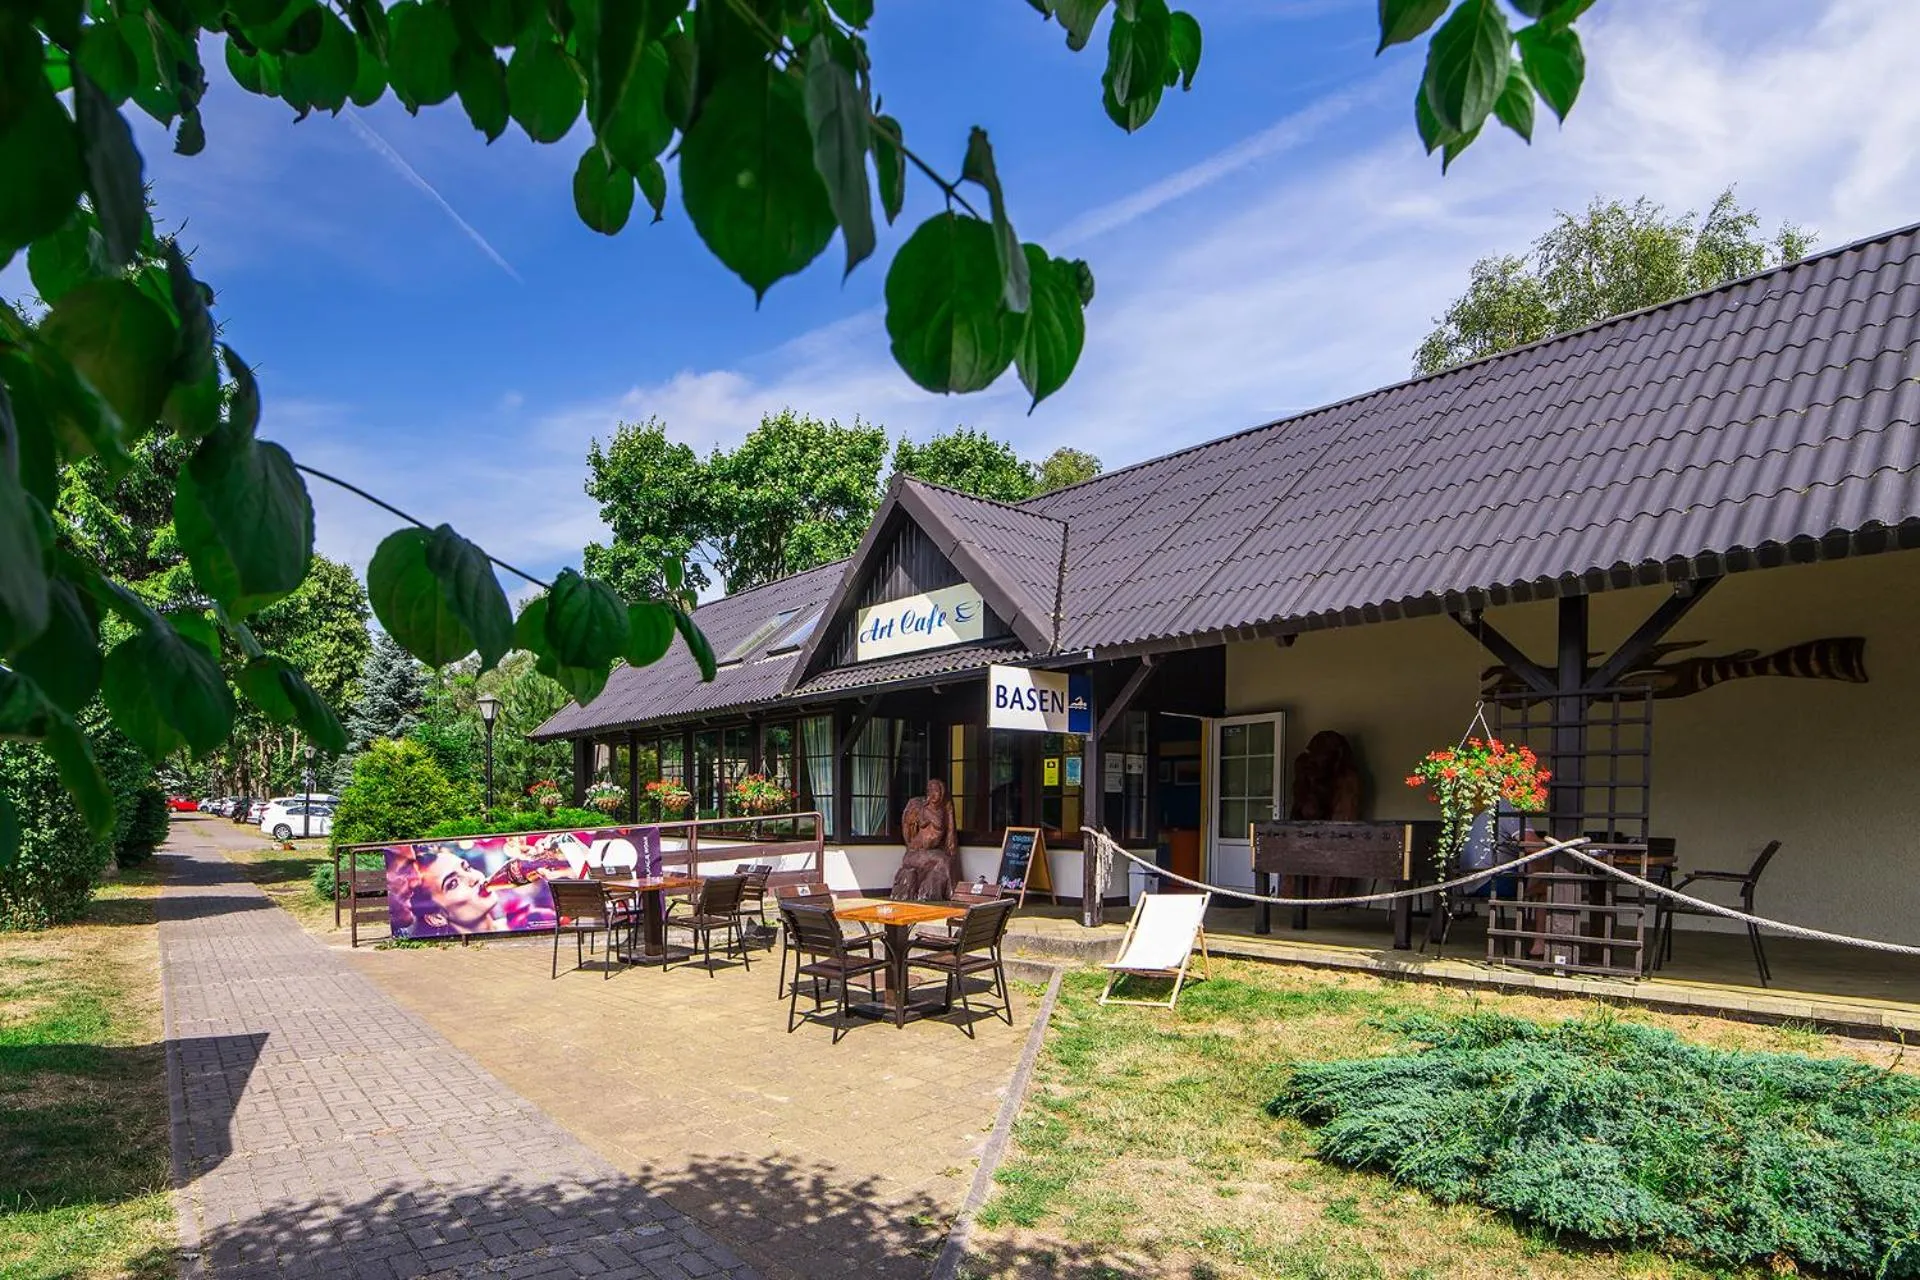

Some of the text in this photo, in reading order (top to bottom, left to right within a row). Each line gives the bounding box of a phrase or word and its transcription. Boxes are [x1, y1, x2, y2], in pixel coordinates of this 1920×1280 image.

[859, 603, 947, 644] Art Cafe
[996, 685, 1065, 714] BASEN
